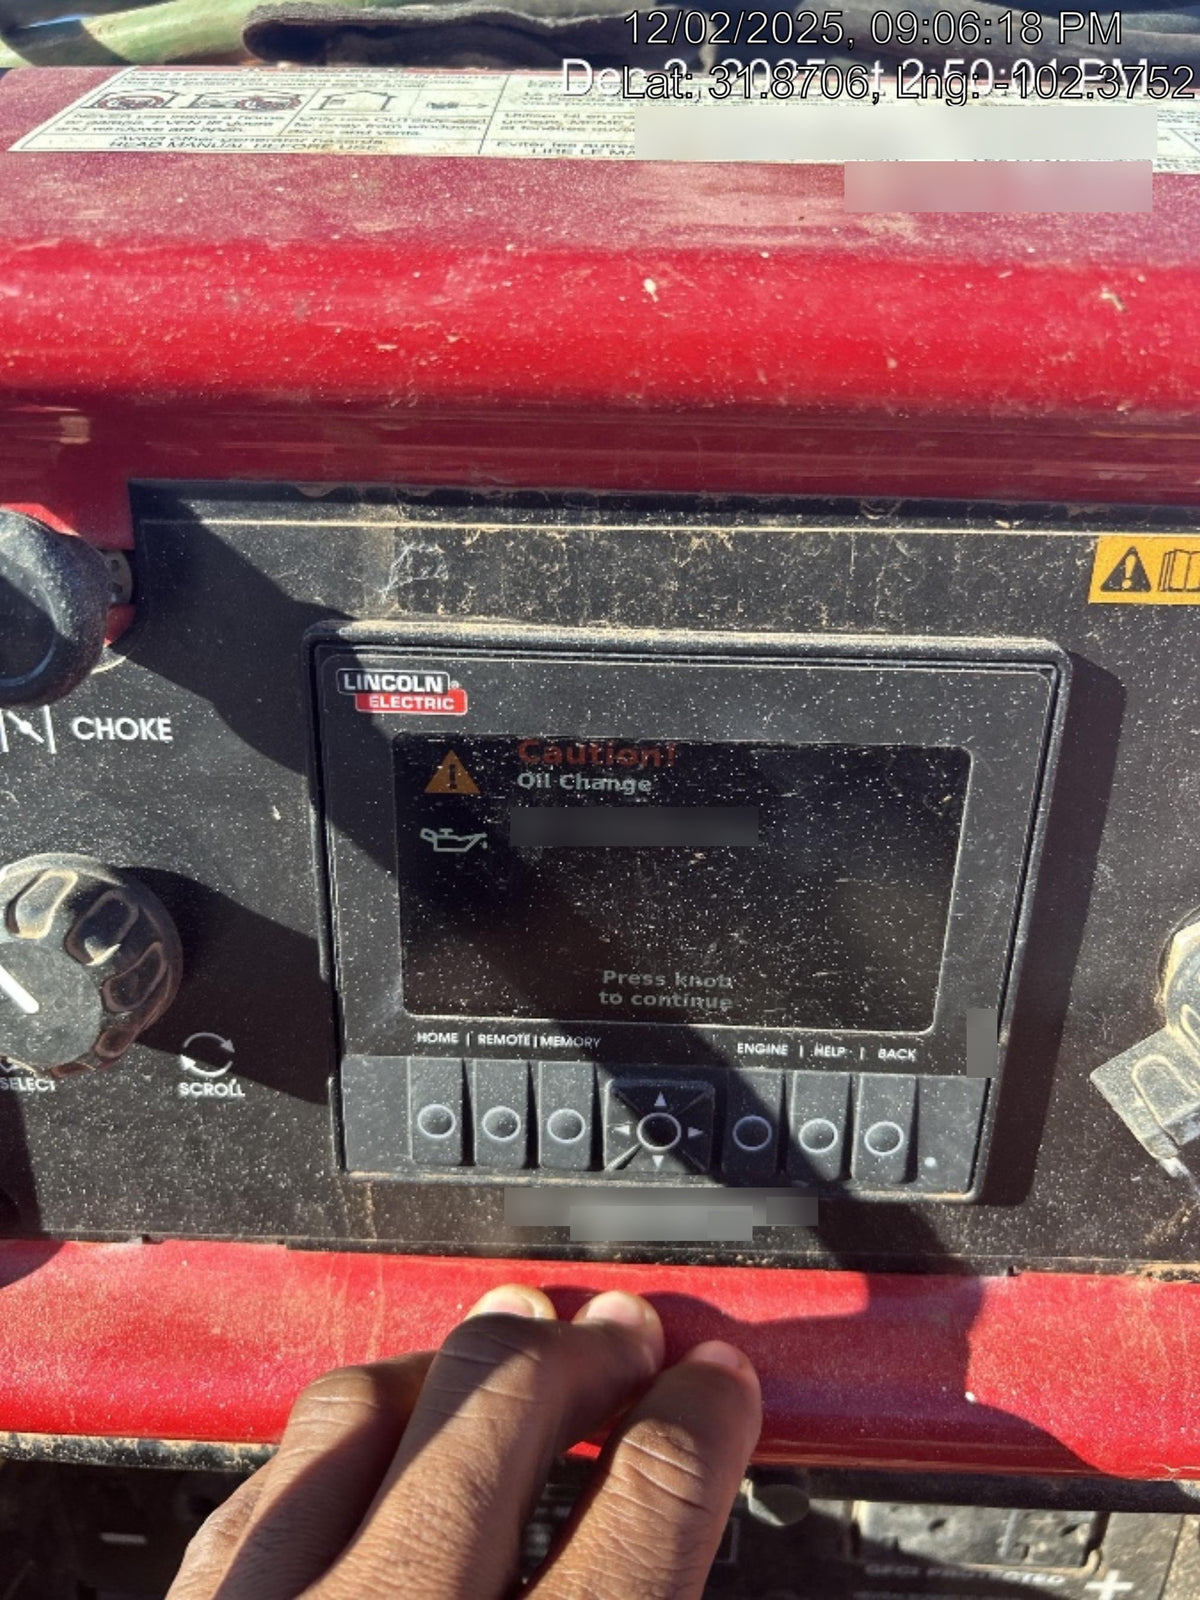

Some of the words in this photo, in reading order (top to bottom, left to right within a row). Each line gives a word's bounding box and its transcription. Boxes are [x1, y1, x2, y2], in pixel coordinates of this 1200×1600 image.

[343, 673, 443, 693] LINCOLN
[369, 695, 455, 710] ELECTRIC
[71, 716, 173, 742] CHOKE
[517, 738, 677, 767] Caution!
[517, 772, 551, 790] Oil
[559, 772, 652, 796] Change
[602, 969, 666, 986] Press
[674, 971, 734, 989] knob
[598, 990, 624, 1006] to
[630, 992, 734, 1011] continue
[416, 1032, 460, 1045] HOME
[477, 1033, 531, 1047] REMOTE
[540, 1035, 602, 1049] MEMORY
[736, 1042, 789, 1056] ENGINE
[814, 1044, 847, 1058] HELP
[877, 1048, 918, 1062] BACK
[179, 1081, 247, 1098] SCROLL
